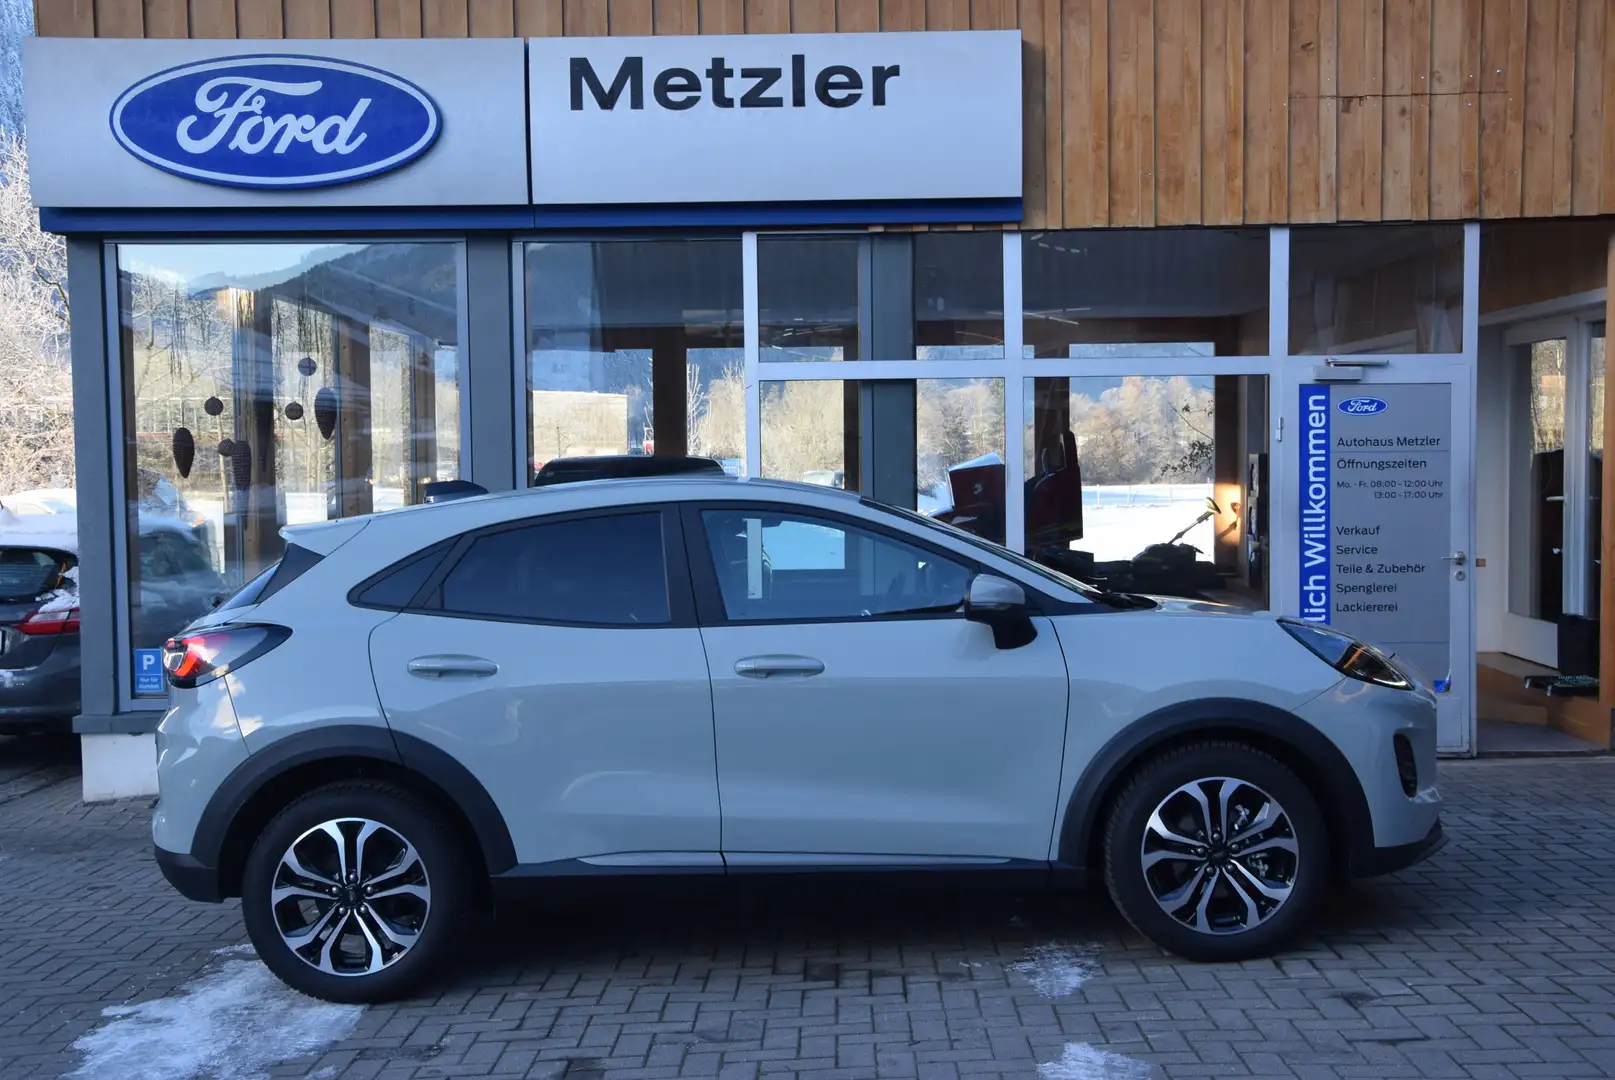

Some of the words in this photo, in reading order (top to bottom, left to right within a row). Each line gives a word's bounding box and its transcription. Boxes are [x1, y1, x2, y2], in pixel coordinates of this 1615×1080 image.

[569, 54, 900, 111] Metzler
[176, 76, 372, 155] Ford
[1347, 399, 1378, 412] Ford
[1336, 437, 1394, 447] Autohaus
[1396, 436, 1441, 447] Metzler
[1336, 457, 1427, 471] Öffnungszeiten
[1303, 395, 1326, 568] Willkommen
[1370, 480, 1397, 488] 08:00
[1404, 480, 1427, 488] 12:00
[1374, 491, 1397, 499] 13:00
[1404, 491, 1427, 499] 17:00
[1336, 525, 1380, 536] Verkauf
[1336, 545, 1378, 555] Service
[1336, 564, 1363, 574] Teile
[1365, 564, 1374, 574] &
[1377, 564, 1426, 574] Zubehör
[1336, 583, 1397, 595] Spenglerei
[1303, 575, 1326, 623] lich
[1336, 602, 1398, 612] Lackiererei
[143, 654, 155, 671] P
